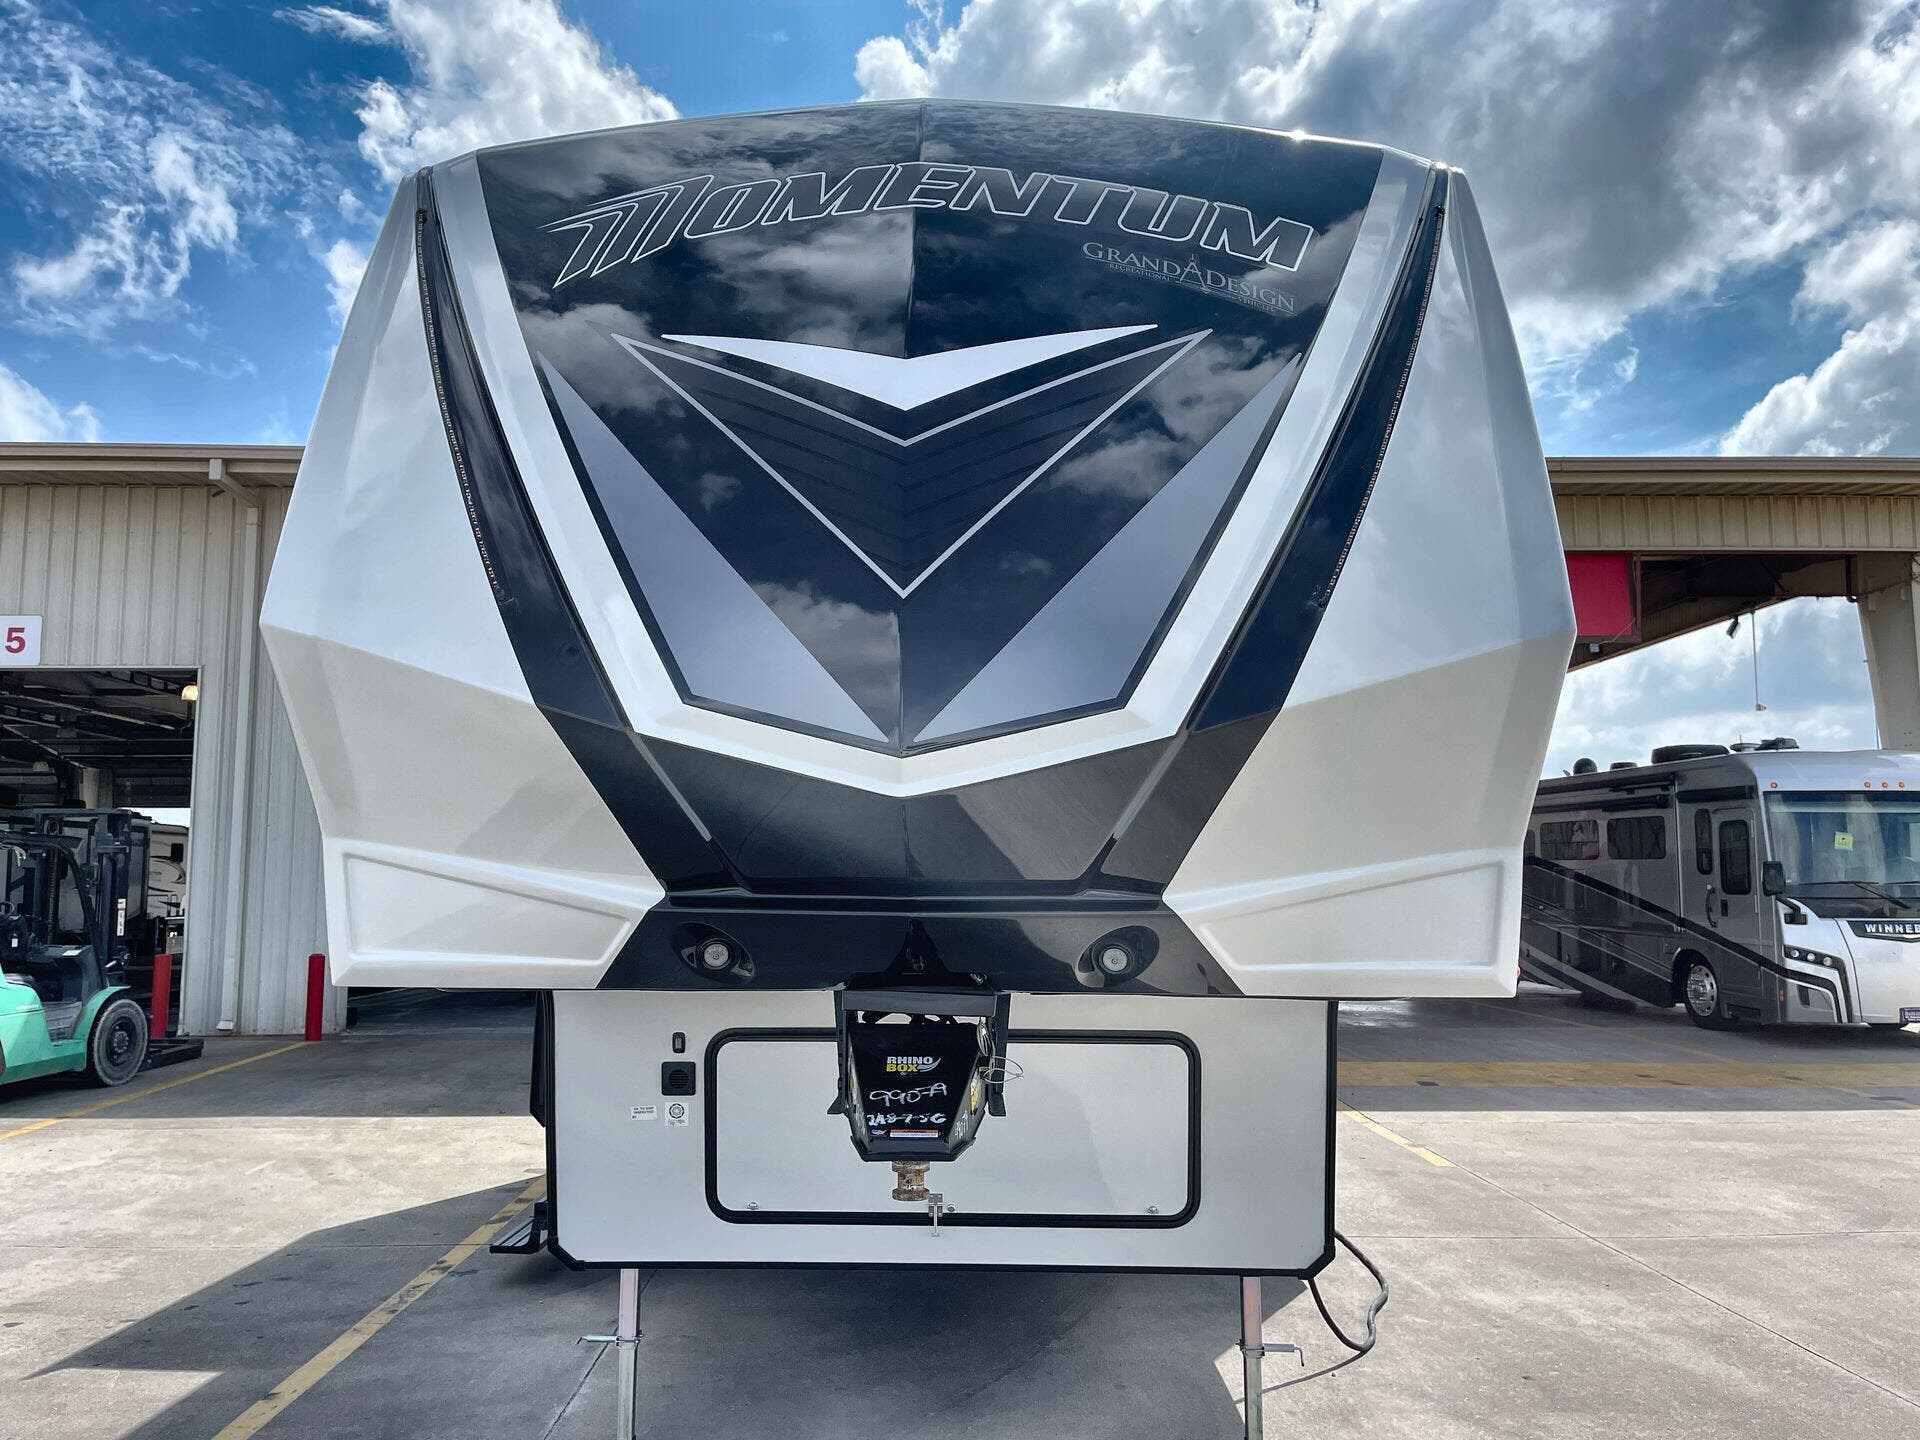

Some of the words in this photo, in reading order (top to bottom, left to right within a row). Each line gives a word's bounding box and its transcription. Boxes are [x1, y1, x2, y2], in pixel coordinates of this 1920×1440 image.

[537, 161, 1316, 288] MOMENTUM
[1082, 242, 1181, 277] GRAND
[1206, 269, 1295, 312] DESIGN
[5, 627, 26, 654] 5
[886, 1056, 934, 1064] RHINO
[886, 1063, 918, 1072] BOX
